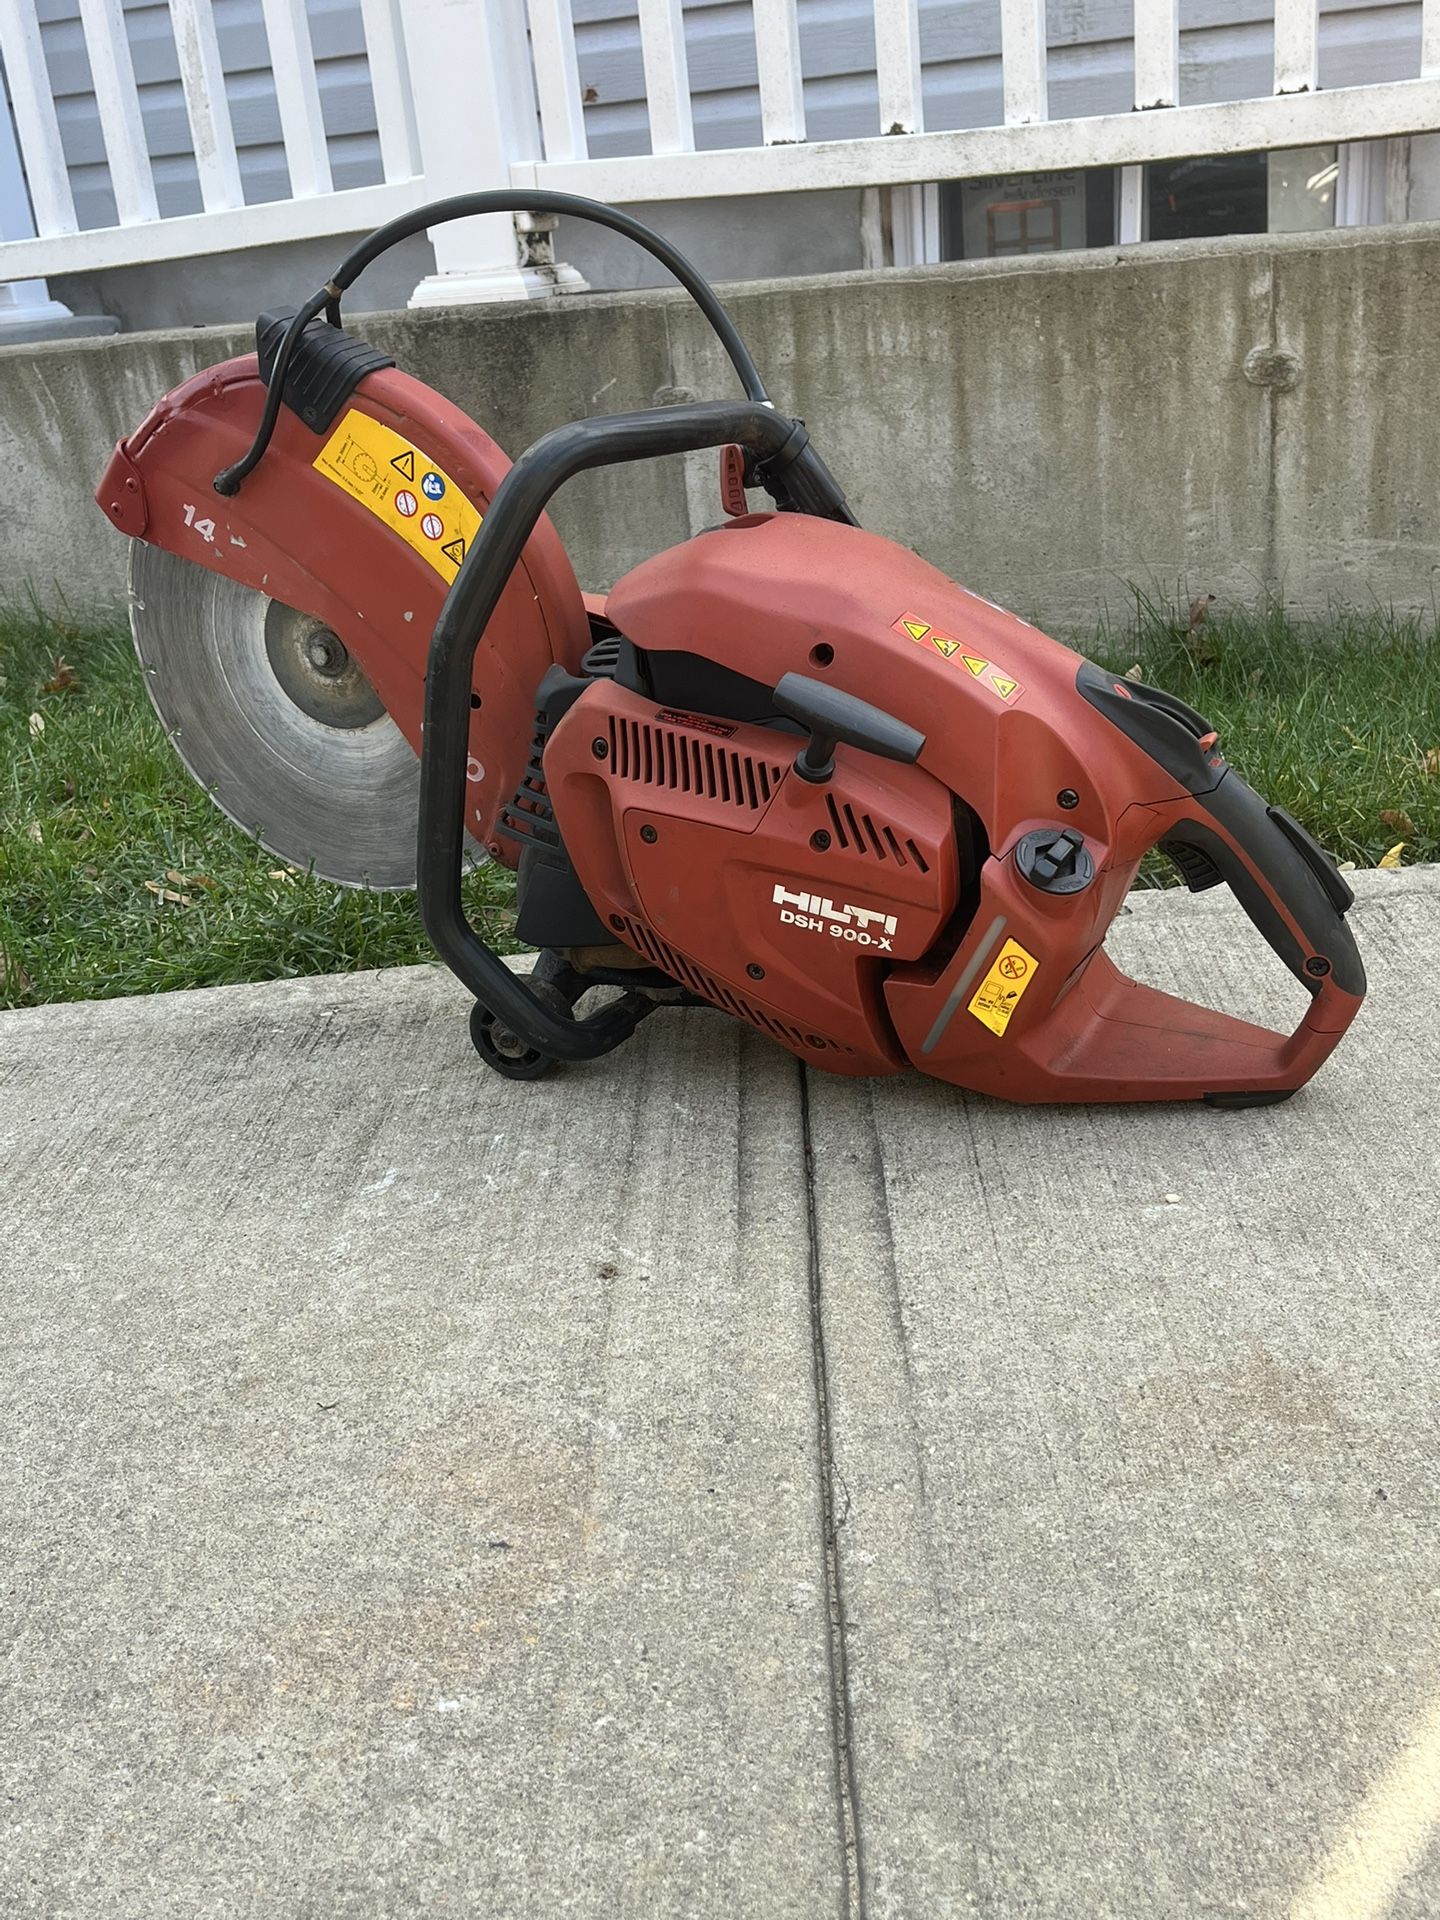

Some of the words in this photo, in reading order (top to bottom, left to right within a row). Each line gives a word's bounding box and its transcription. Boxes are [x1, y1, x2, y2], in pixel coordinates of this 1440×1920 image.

[773, 884, 898, 935] HILTI
[780, 909, 824, 933] DSH
[829, 925, 893, 951] 900-X
